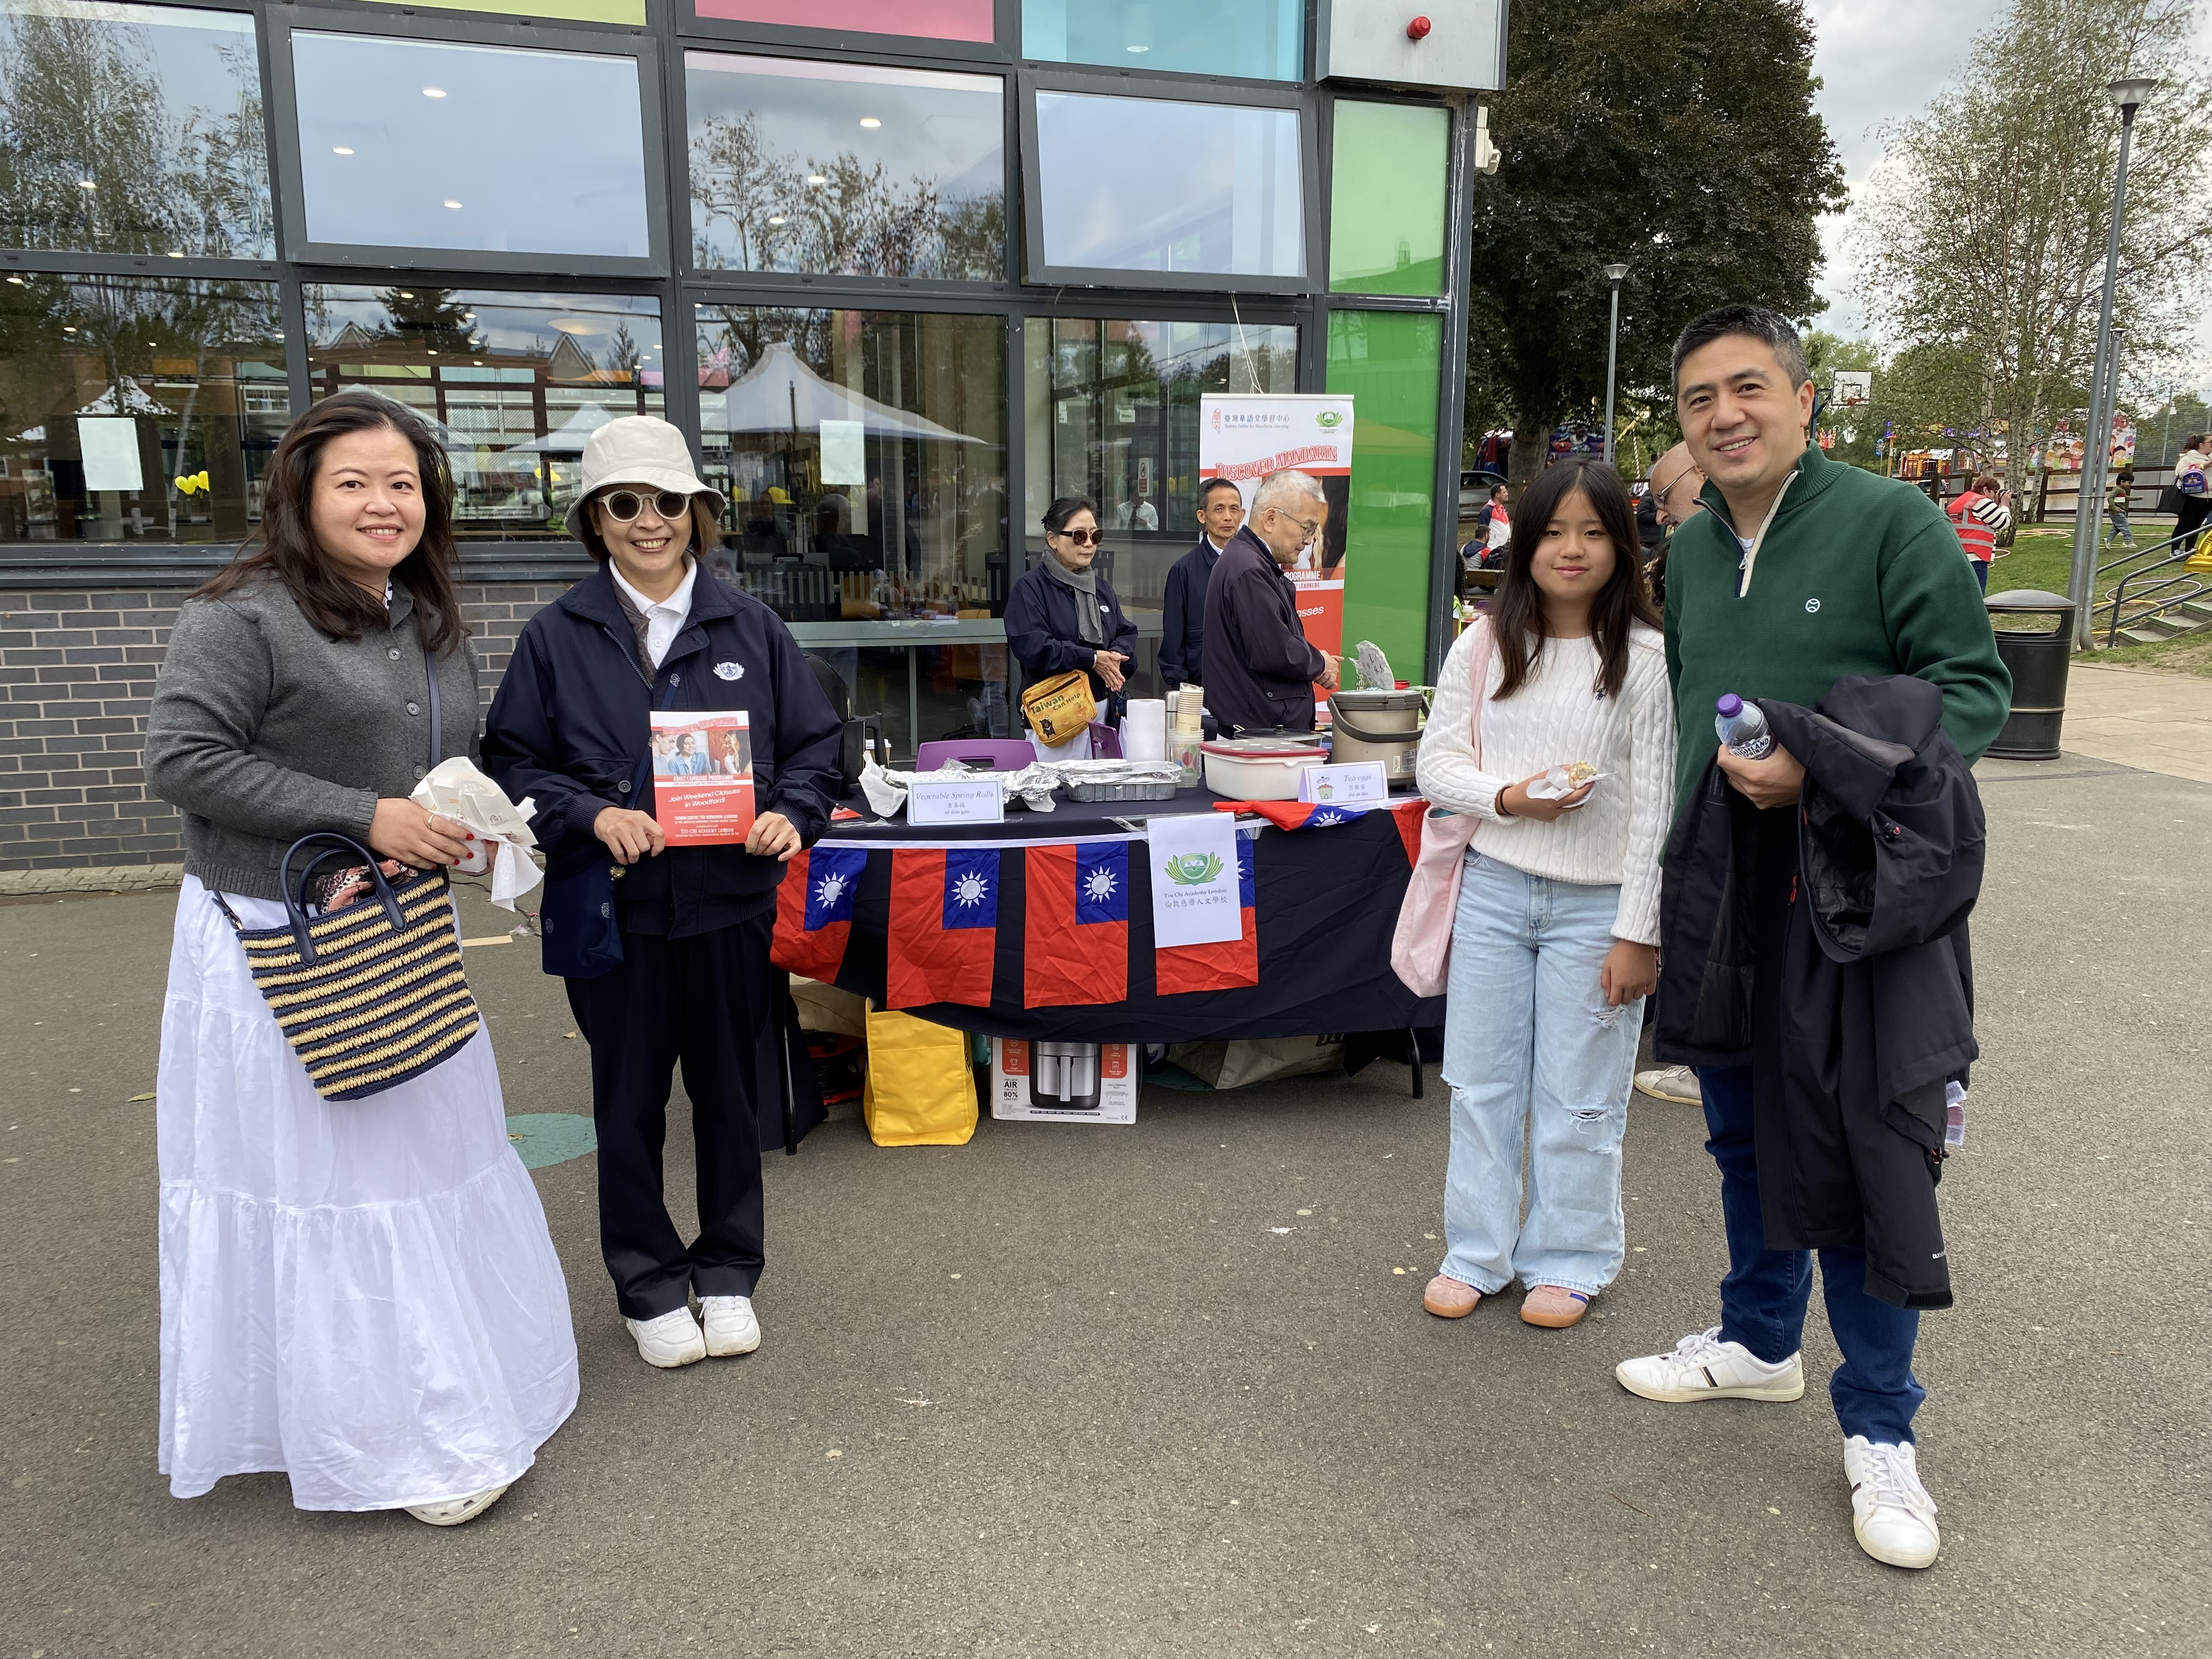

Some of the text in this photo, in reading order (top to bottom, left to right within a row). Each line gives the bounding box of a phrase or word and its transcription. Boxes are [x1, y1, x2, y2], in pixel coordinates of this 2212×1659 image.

[1216, 445, 1337, 481] DISCOVER MANDARIN
[1296, 606, 1324, 618] asses
[1030, 695, 1064, 714] Taiwan
[1053, 703, 1065, 711] Can
[1065, 692, 1081, 704] Help
[1732, 738, 1769, 757] HIGHLAND
[684, 791, 713, 800] Weekend
[692, 797, 725, 806] Woodford!
[916, 792, 950, 800] Vegetable
[951, 792, 974, 800] Spring
[1165, 896, 1228, 909] 倫敦慈濟人文學校
